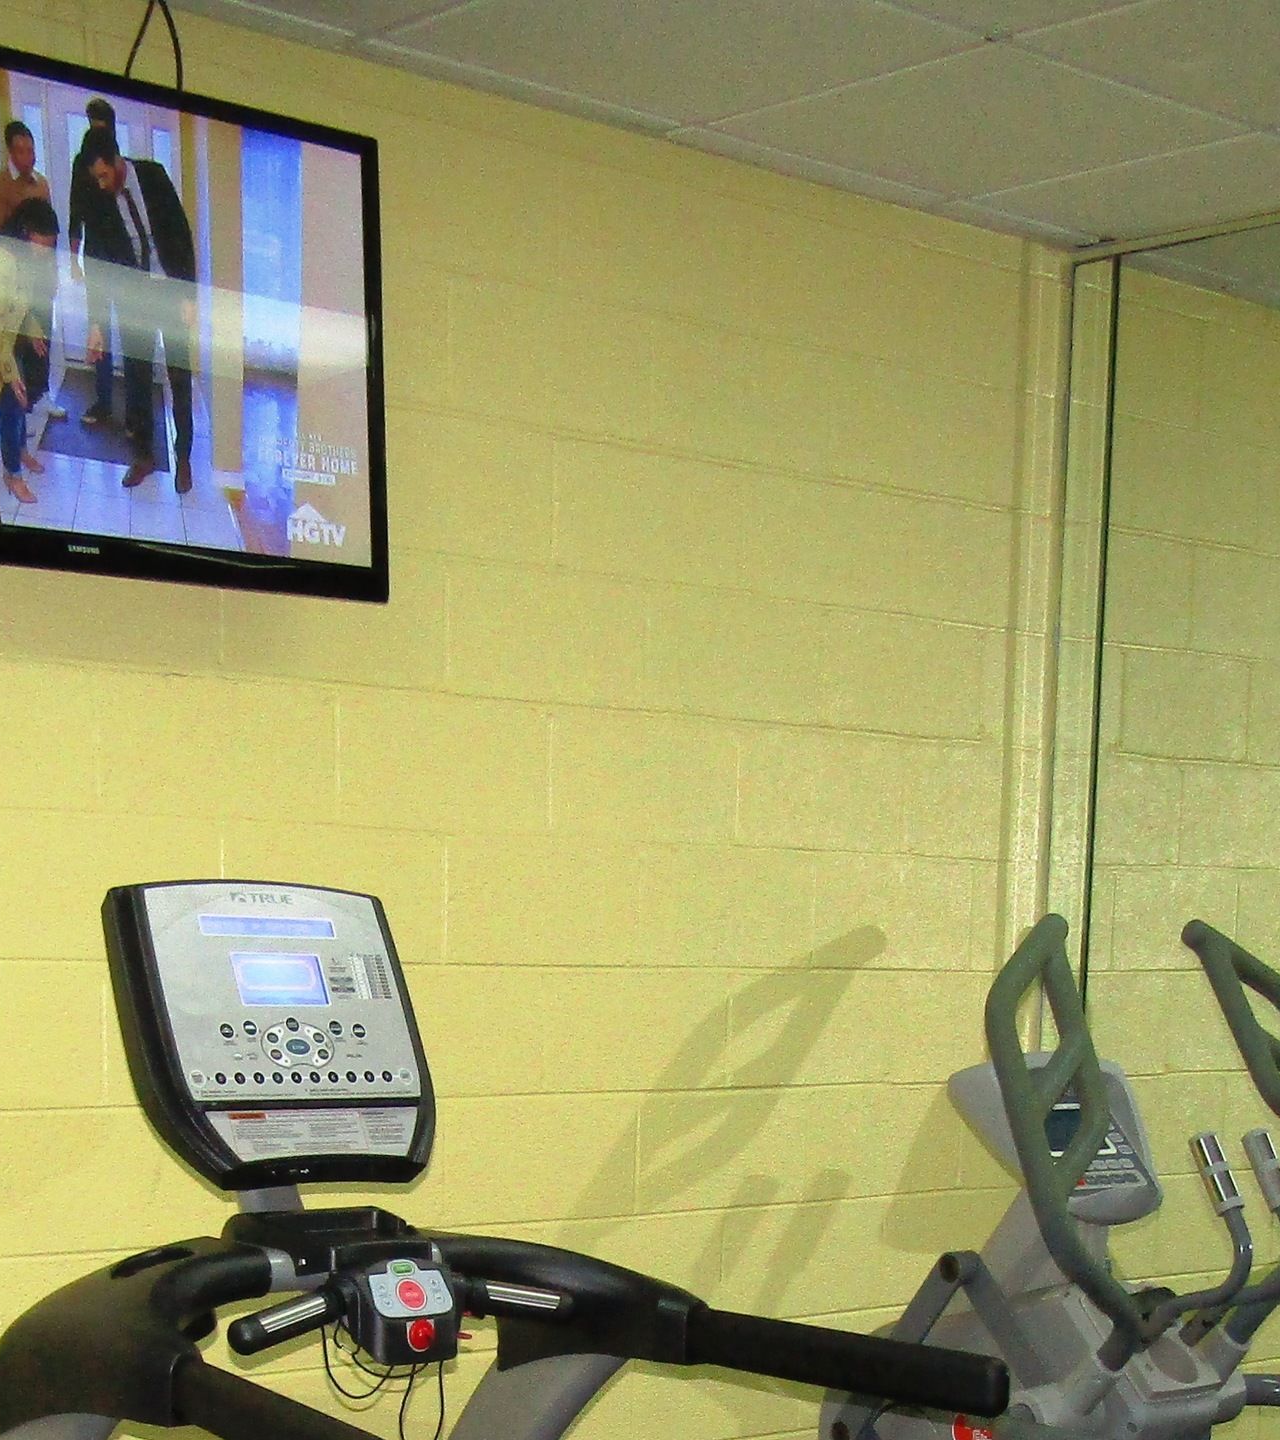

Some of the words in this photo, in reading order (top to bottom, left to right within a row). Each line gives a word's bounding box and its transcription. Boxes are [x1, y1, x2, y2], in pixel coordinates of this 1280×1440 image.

[321, 456, 359, 475] HOME
[286, 516, 346, 547] HGTV
[250, 892, 294, 905] TRUE
